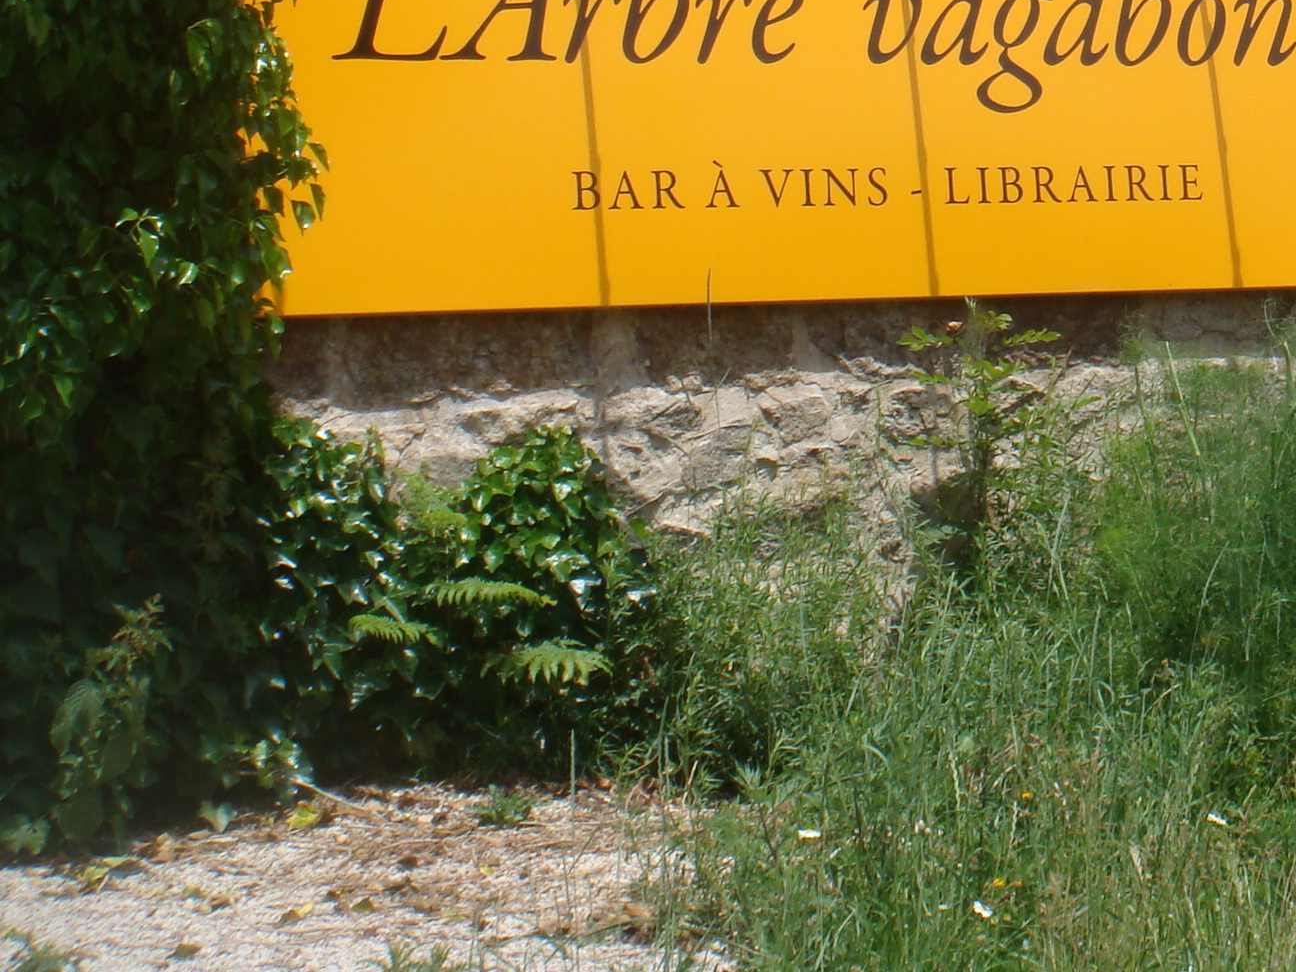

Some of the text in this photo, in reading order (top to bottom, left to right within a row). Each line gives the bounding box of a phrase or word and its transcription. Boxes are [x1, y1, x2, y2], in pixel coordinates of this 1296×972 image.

[572, 170, 686, 210] BAR
[705, 160, 741, 209] À
[759, 167, 888, 207] VINS
[944, 165, 1204, 205] LIBRAIRIE
